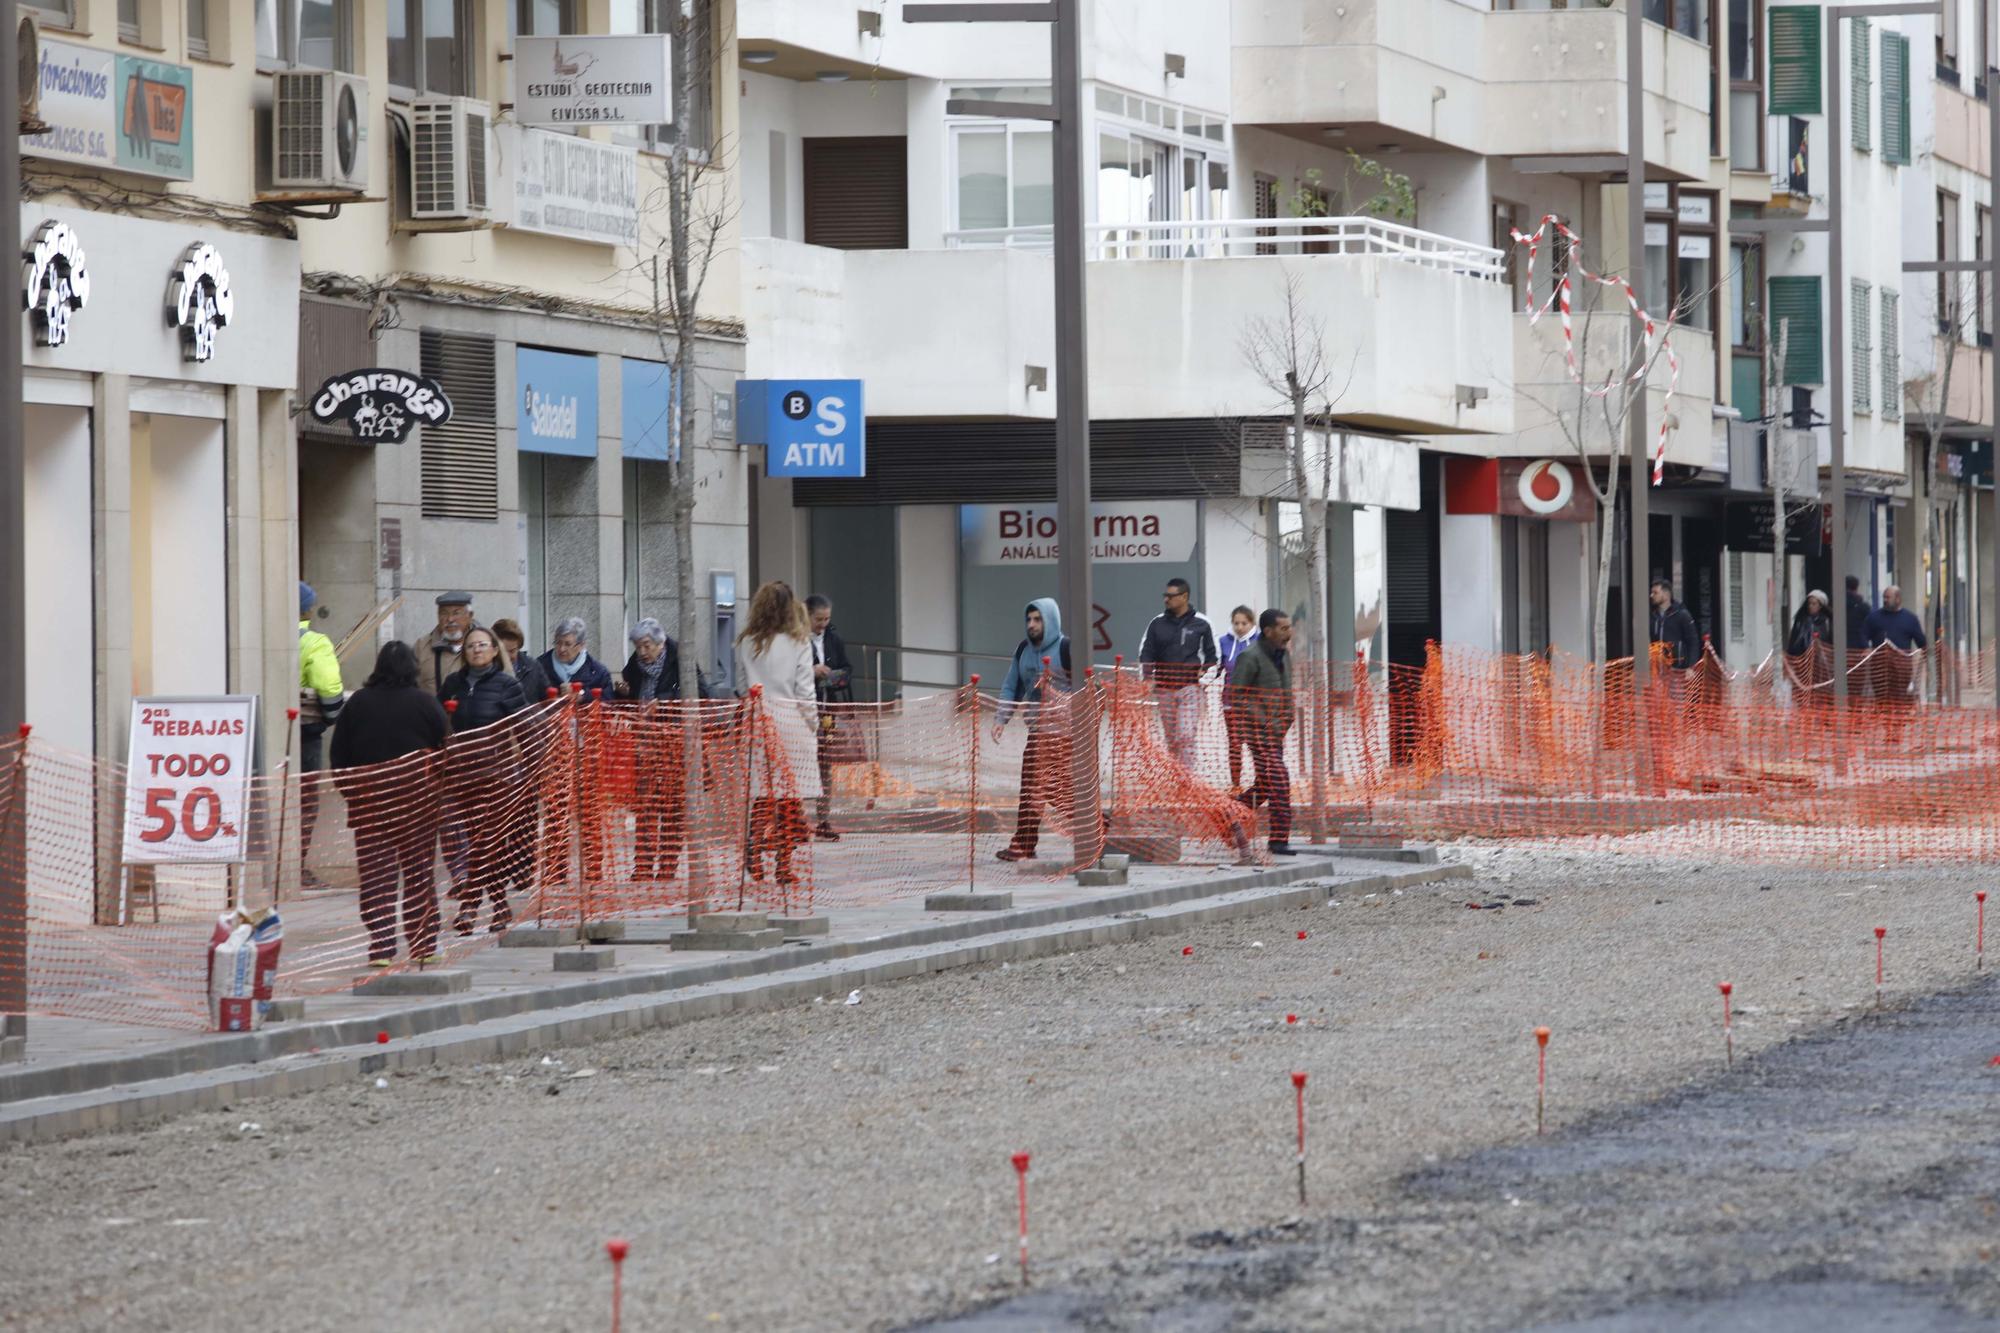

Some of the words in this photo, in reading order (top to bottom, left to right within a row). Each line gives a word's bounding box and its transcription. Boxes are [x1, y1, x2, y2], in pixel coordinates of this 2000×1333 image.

[528, 83, 571, 96] ESTUDI
[585, 82, 652, 96] GEOTECNIA
[551, 107, 599, 121] EIVISSA
[604, 106, 625, 120] S.L.
[531, 391, 577, 439] Sabadell
[789, 396, 806, 414] B
[814, 396, 847, 437] S
[783, 442, 846, 467] ATM
[1000, 510, 1161, 539] Biorma
[1000, 542, 1060, 560] ANÁLIS
[1091, 541, 1162, 558] LÍNICOS
[152, 718, 244, 737] REBAJAS
[146, 752, 232, 778] TODO
